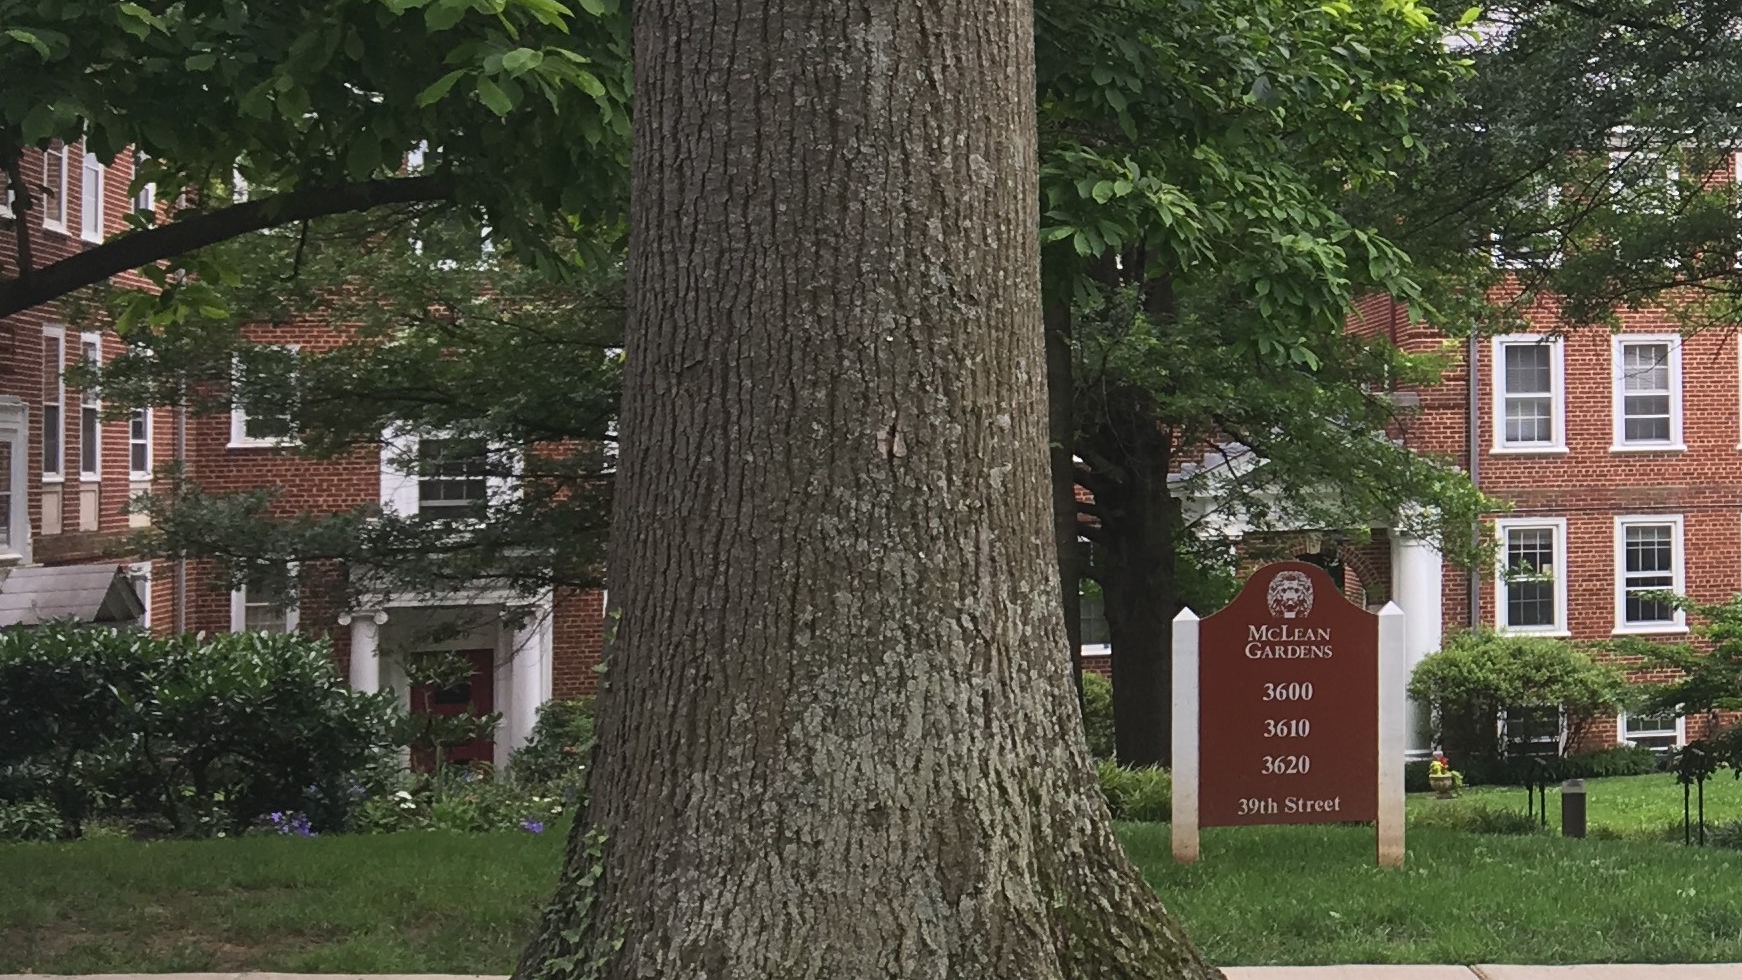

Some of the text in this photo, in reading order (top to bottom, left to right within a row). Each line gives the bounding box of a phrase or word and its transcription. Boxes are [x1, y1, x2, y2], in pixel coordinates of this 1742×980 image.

[1244, 641, 1333, 659] GARDENS
[1262, 682, 1313, 701] 3600
[1263, 718, 1310, 738] 3610
[1261, 755, 1310, 775] 3620
[1237, 796, 1341, 816] 39th Street
